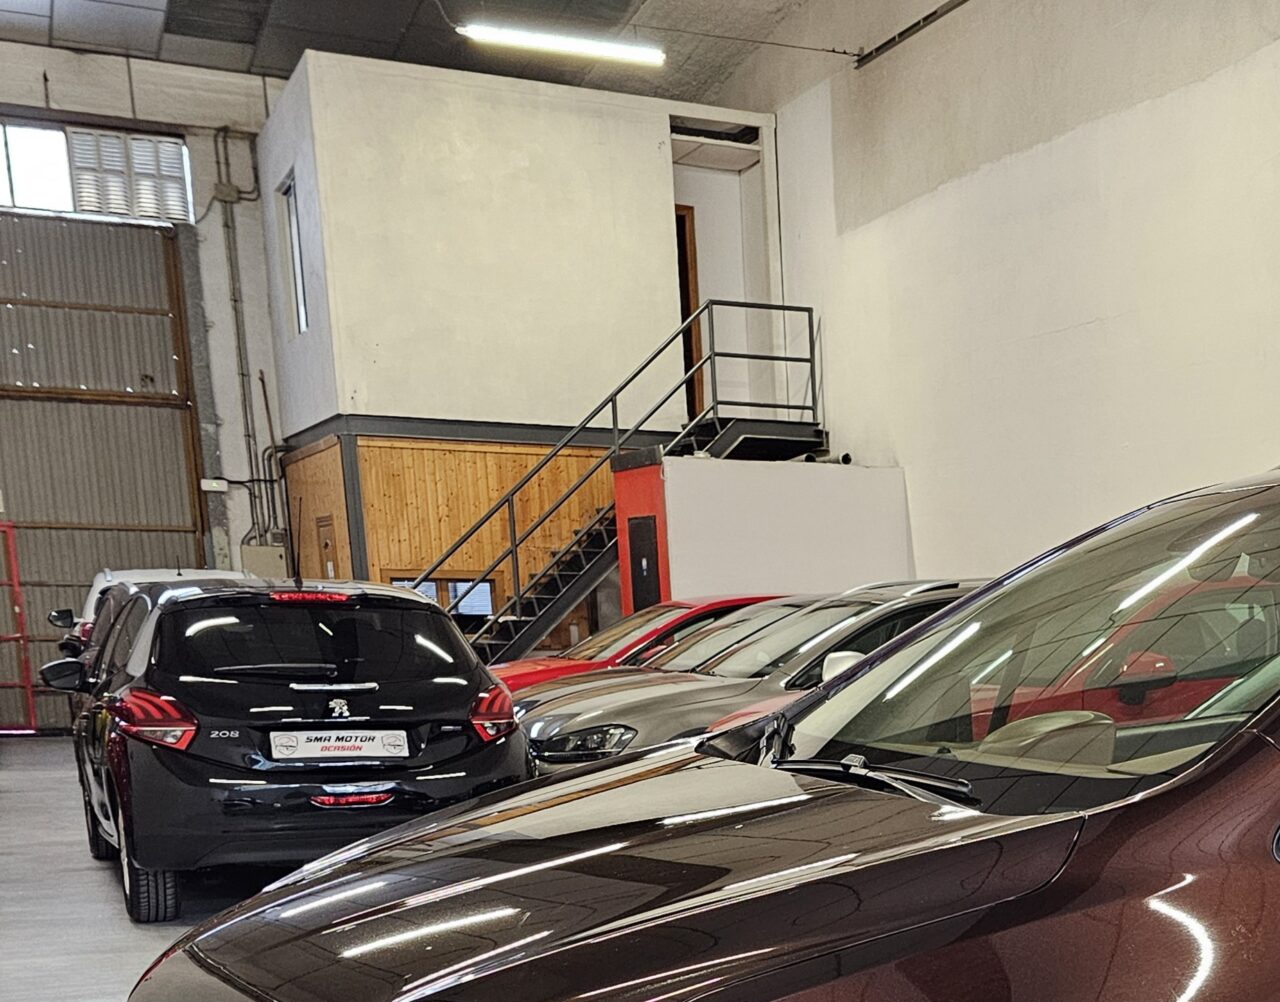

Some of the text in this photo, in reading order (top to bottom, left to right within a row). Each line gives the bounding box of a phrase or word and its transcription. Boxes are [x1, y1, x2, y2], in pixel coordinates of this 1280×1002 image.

[210, 730, 240, 738] 208
[305, 735, 376, 744] SMA MOTOR
[320, 744, 363, 752] OCASIÓN
